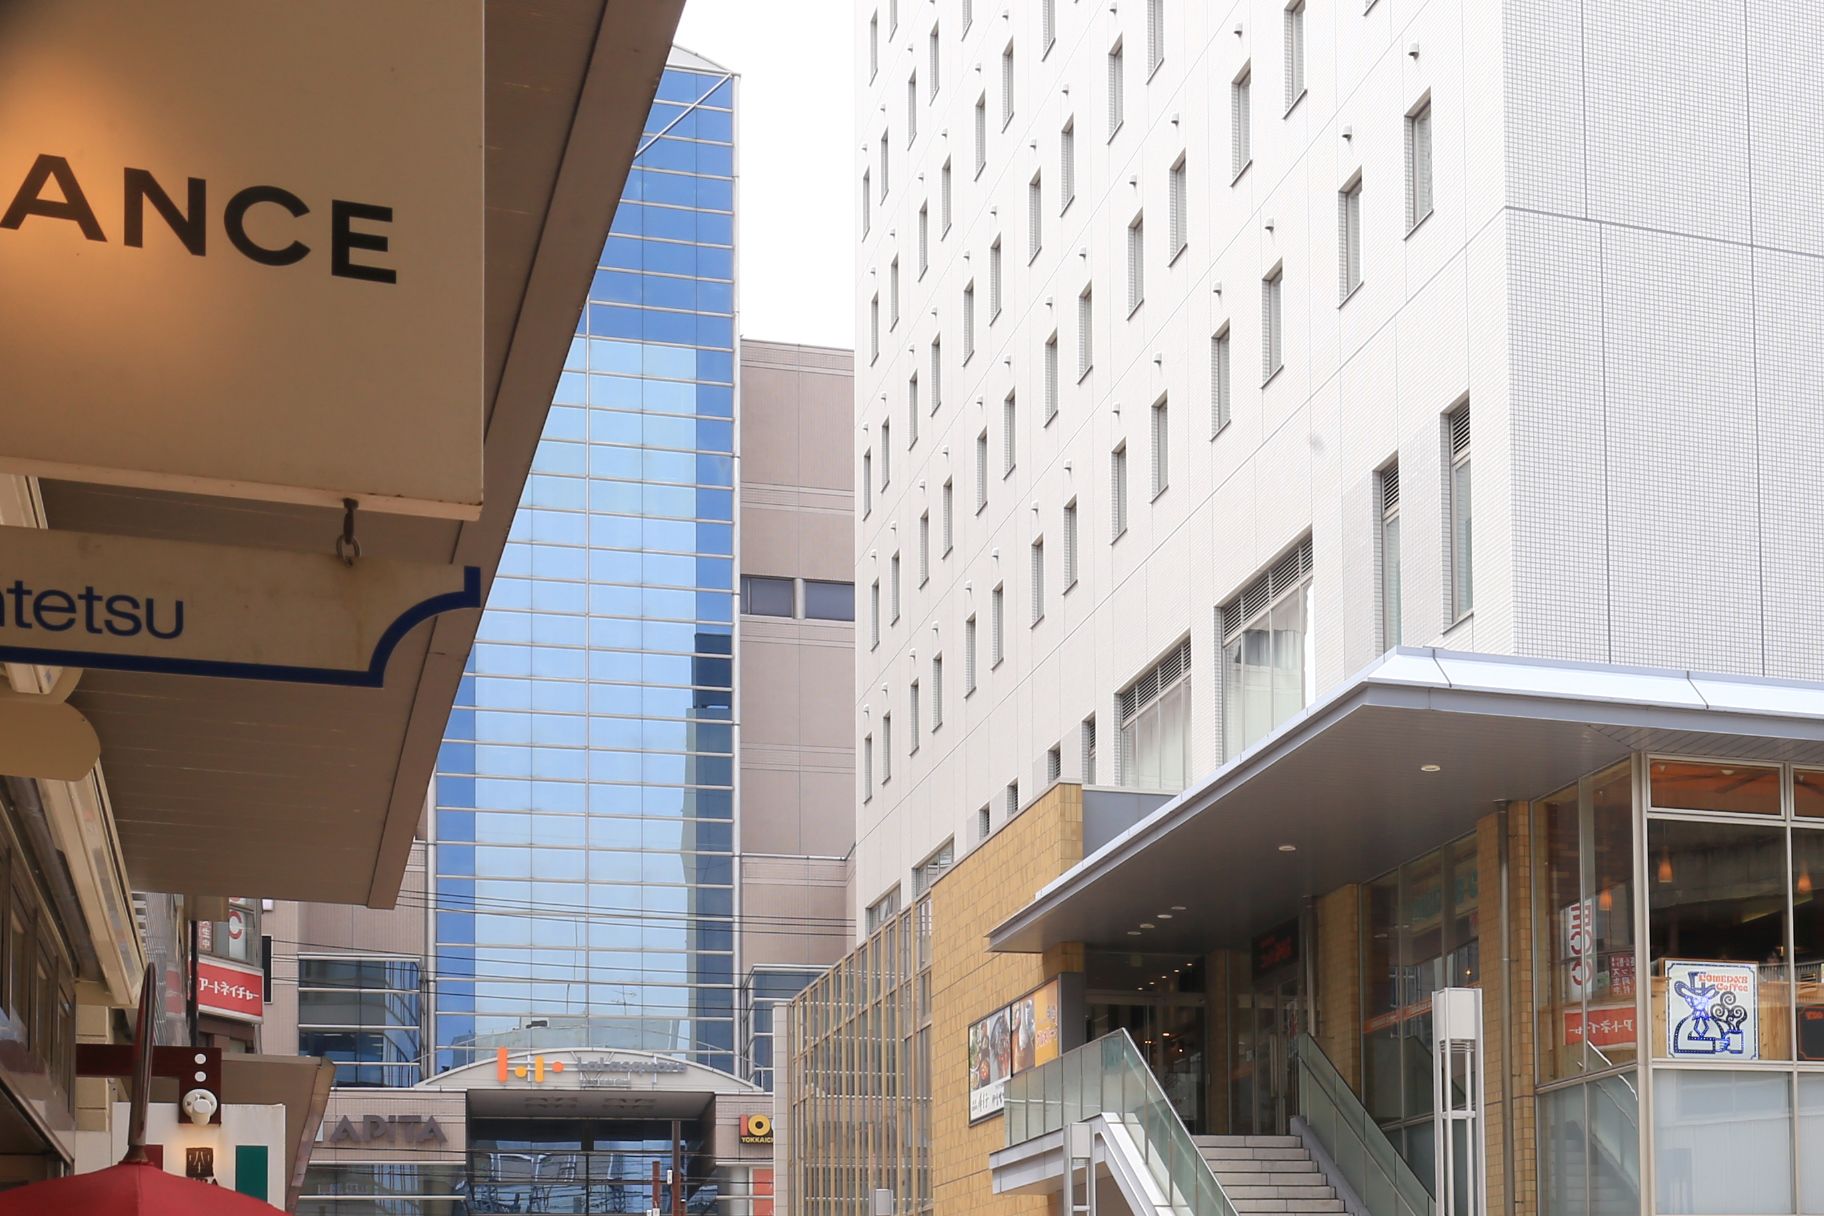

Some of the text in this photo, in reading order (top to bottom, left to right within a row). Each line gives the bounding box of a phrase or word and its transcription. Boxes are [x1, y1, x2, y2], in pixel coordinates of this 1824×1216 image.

[0, 153, 397, 284] ANCE
[0, 580, 185, 640] tetsu
[199, 976, 260, 1001] アートネイチャー
